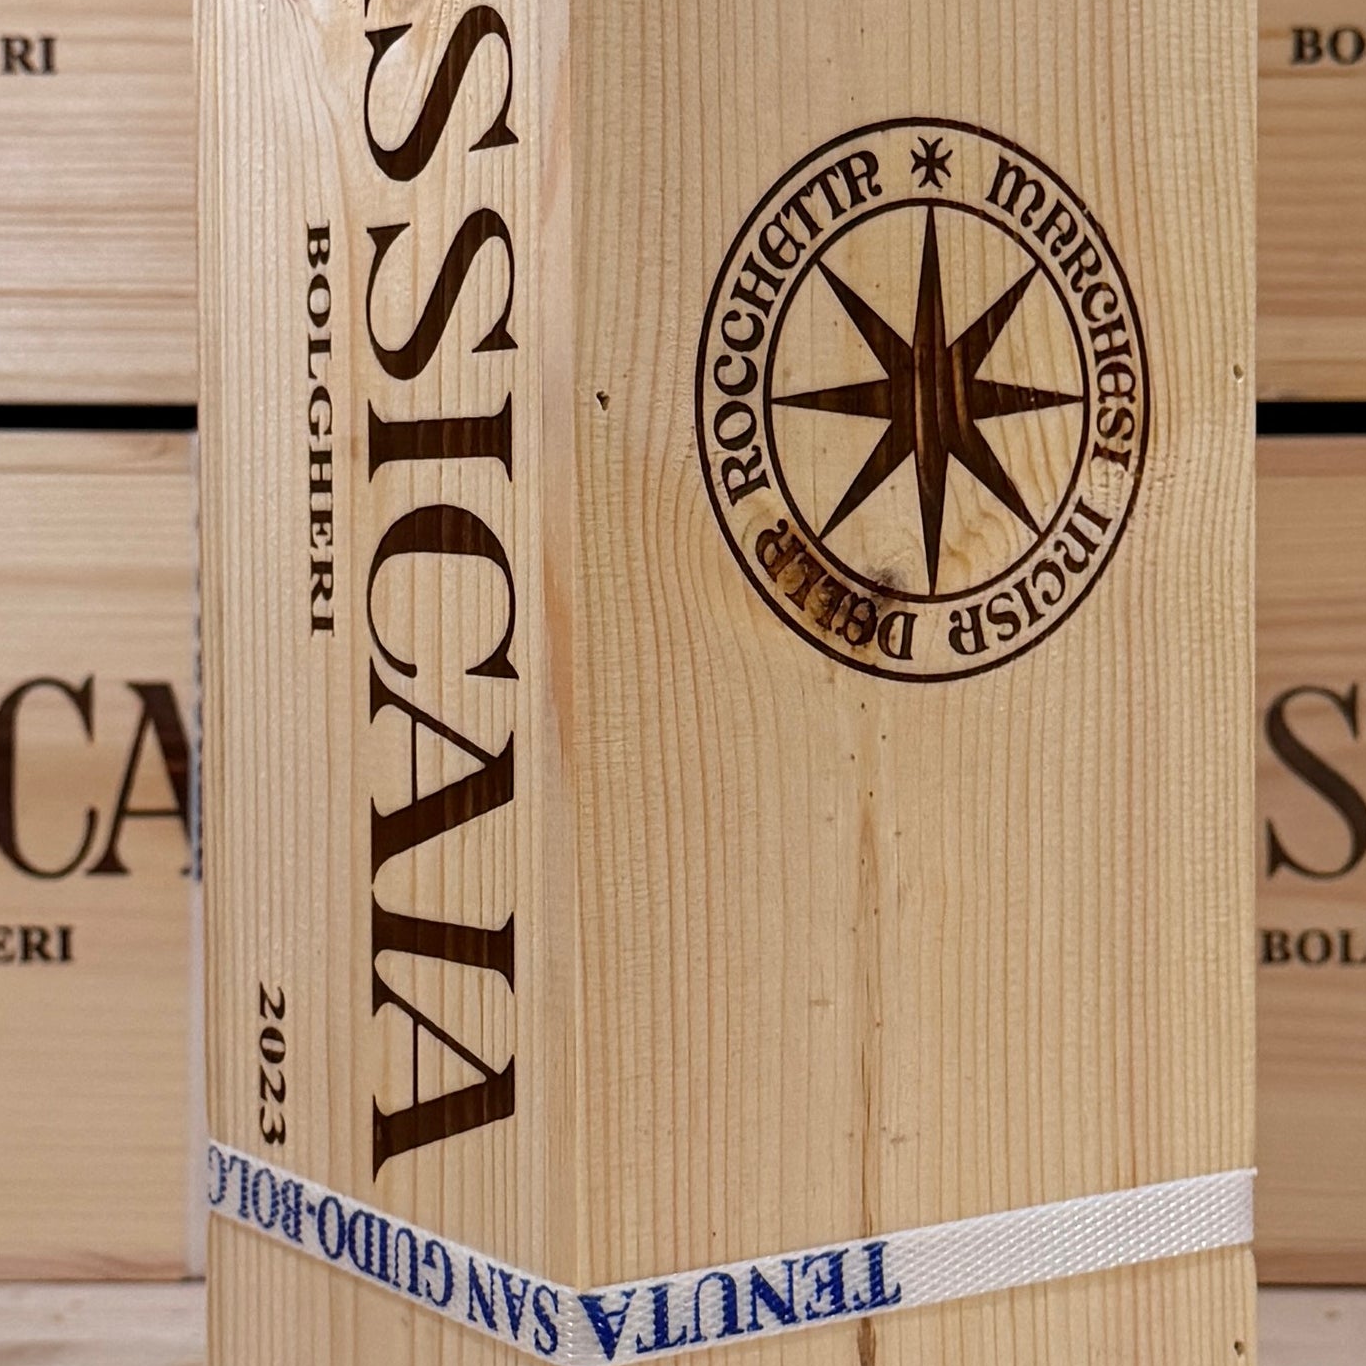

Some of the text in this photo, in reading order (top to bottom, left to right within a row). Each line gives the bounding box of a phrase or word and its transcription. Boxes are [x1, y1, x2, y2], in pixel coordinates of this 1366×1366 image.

[306, 219, 335, 638] BOLGHERI
[258, 980, 286, 1146] 2023
[467, 1256, 559, 1356] SAN
[577, 1240, 902, 1362] TENUTA
